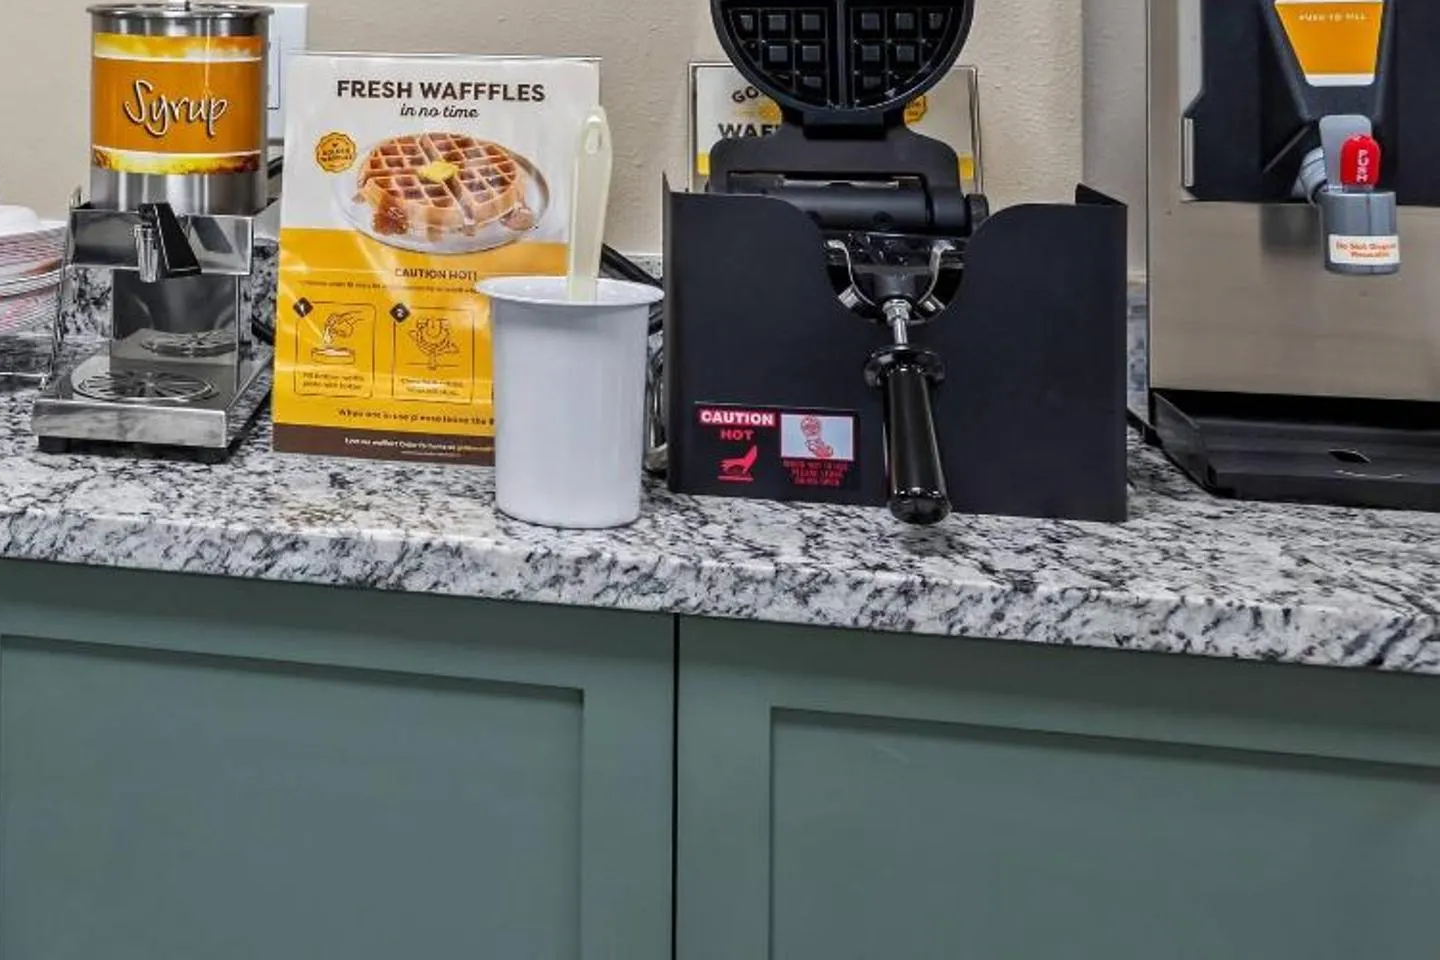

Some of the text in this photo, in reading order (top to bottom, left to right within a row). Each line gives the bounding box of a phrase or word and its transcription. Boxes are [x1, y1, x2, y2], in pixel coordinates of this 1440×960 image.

[337, 79, 413, 99] FRESH
[123, 79, 228, 138] Syrup
[400, 103, 480, 119] in no time
[395, 268, 446, 279] CAUTION
[699, 409, 775, 426] CAUTION
[720, 429, 755, 440] HOT
